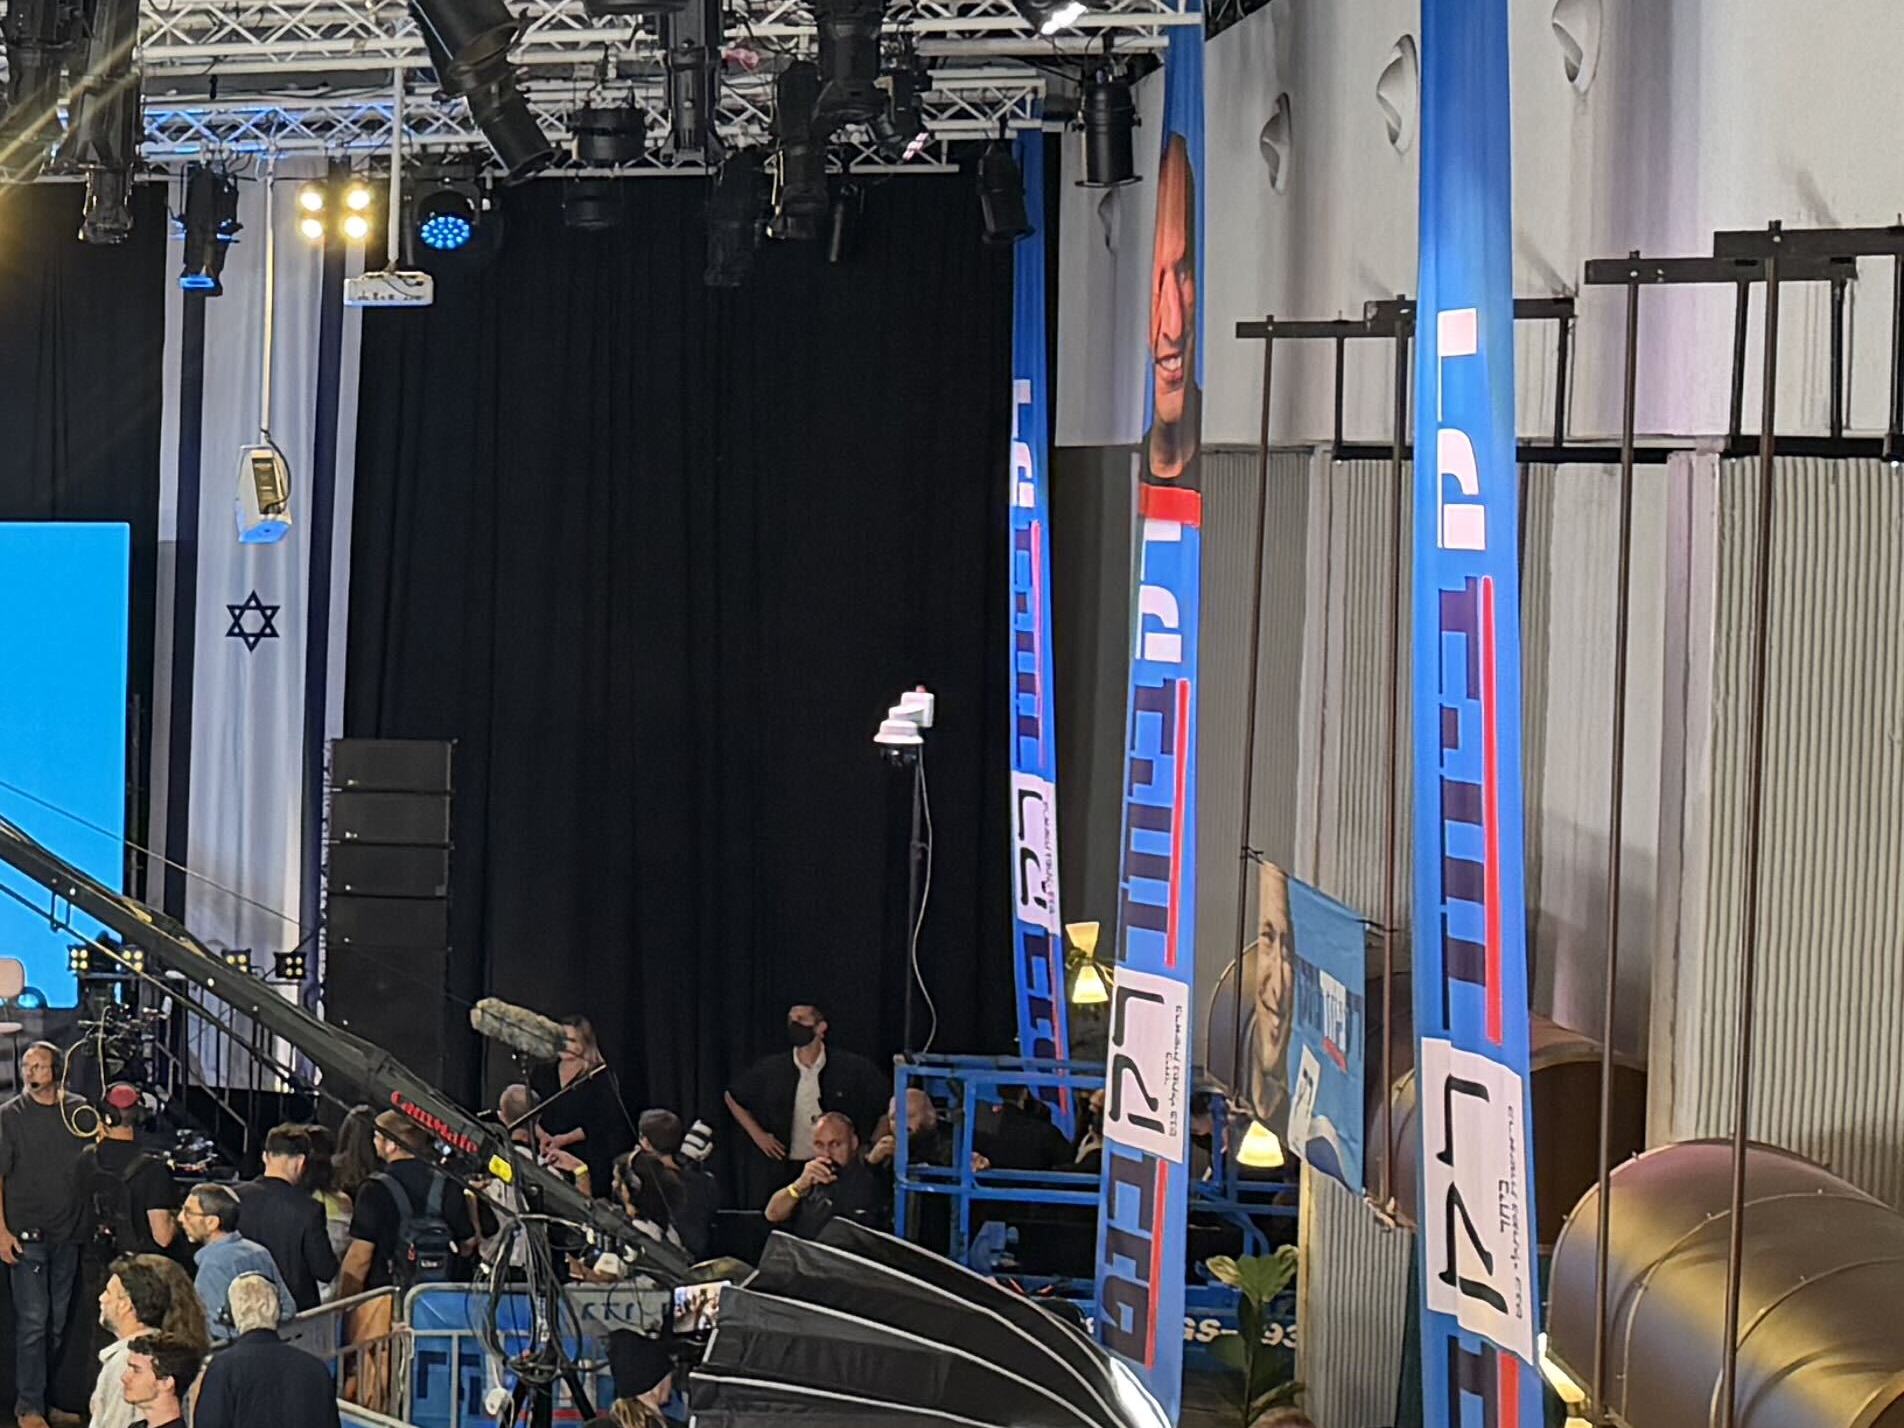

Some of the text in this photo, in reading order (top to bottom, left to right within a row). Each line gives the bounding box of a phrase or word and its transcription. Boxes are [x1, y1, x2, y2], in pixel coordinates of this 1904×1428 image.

[1437, 308, 1486, 550] רק
[1118, 520, 1183, 963] רק ביחד
[1108, 985, 1166, 1134] רק
[1100, 1150, 1156, 1366] בנט
[1437, 1074, 1510, 1316] רק
